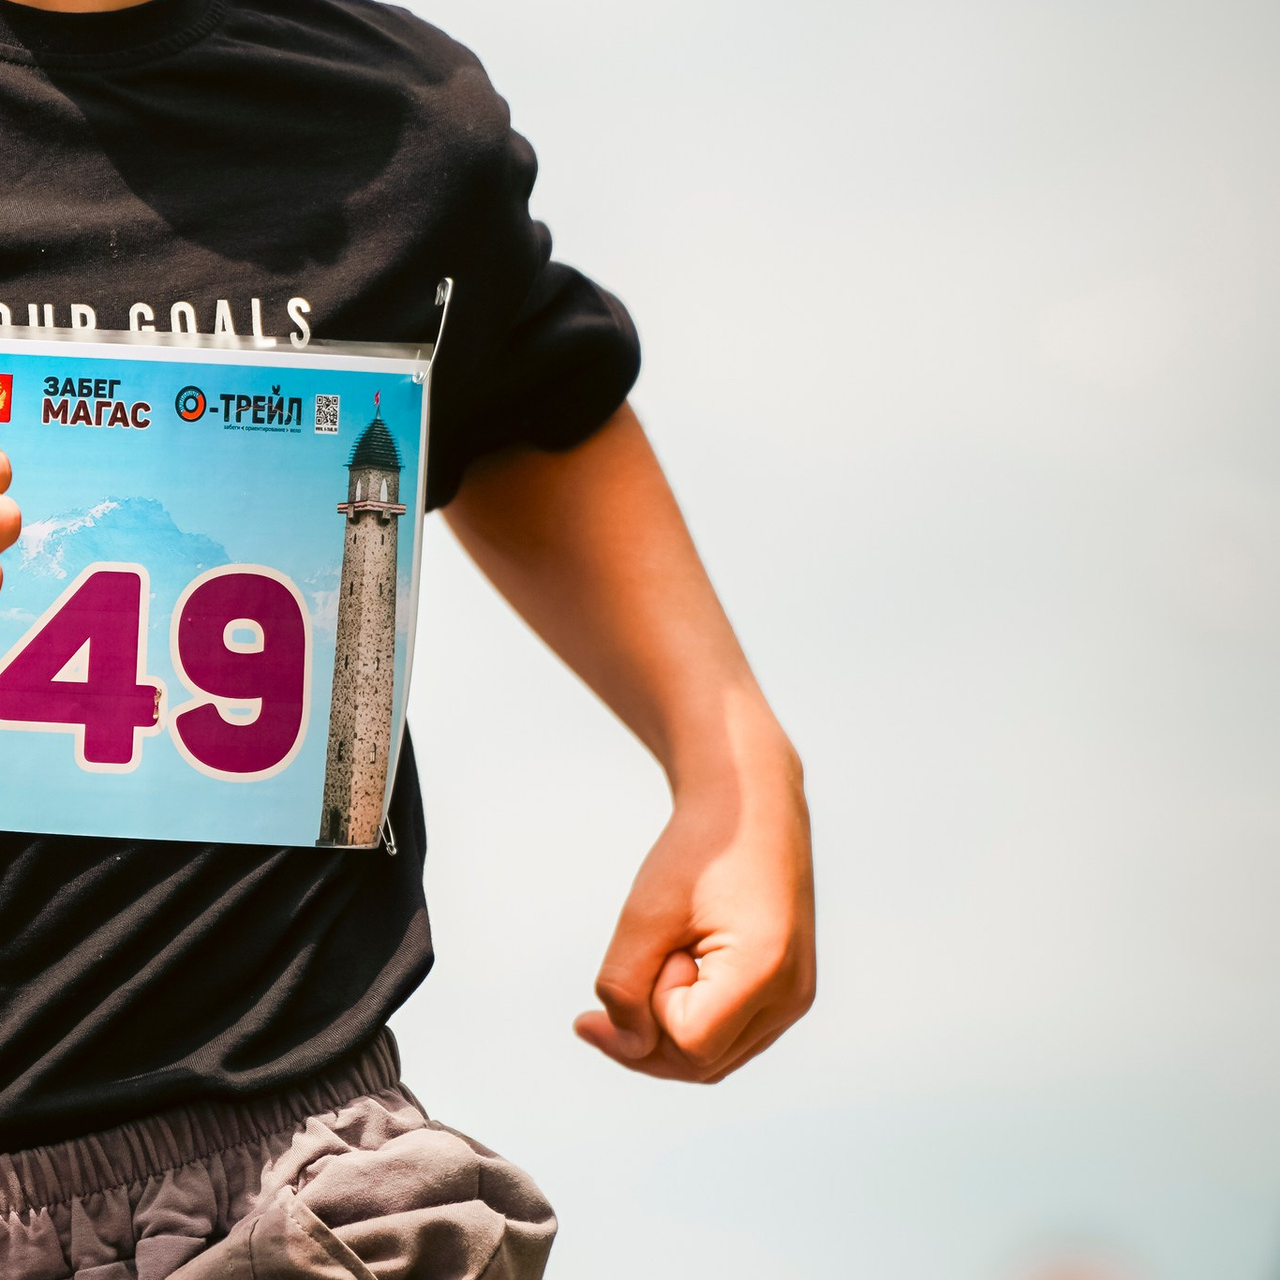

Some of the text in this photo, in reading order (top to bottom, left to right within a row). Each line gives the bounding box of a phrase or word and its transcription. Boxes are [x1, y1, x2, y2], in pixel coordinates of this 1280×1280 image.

[129, 297, 311, 349] GOALS
[43, 376, 121, 399] ЗАБЕГ
[41, 397, 152, 429] МАГАС
